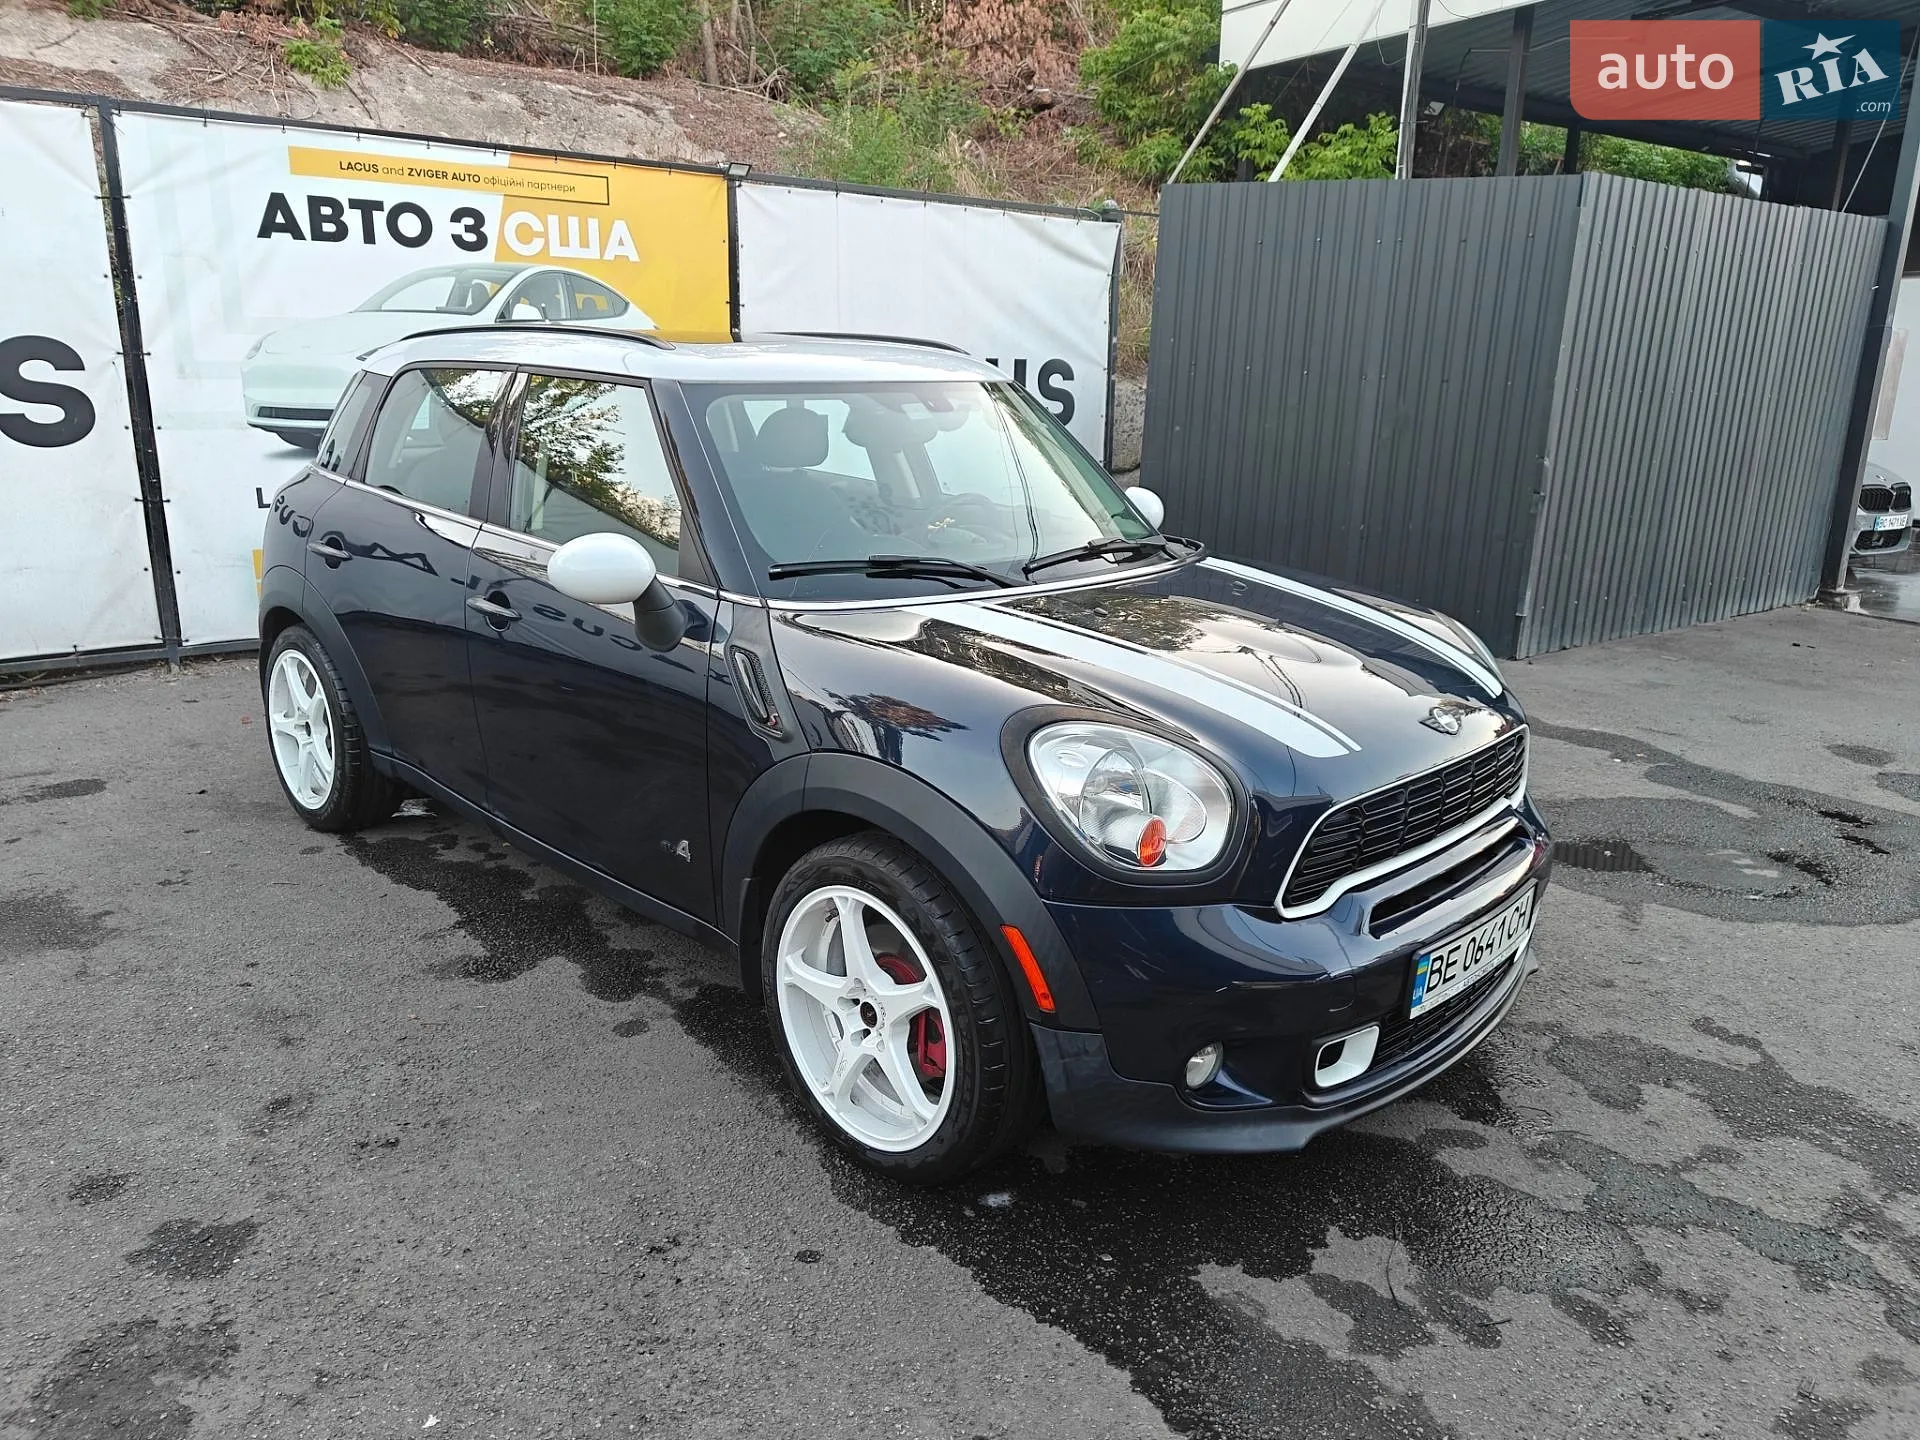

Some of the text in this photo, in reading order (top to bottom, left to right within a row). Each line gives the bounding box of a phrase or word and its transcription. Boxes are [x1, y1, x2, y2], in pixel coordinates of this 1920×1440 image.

[339, 160, 576, 194] LACUS and ZVIGER AUTO офіційні партнери
[257, 192, 433, 249] АВТО
[503, 211, 641, 263] США
[1425, 944, 1462, 994] BE
[1463, 915, 1507, 972] 0641
[1508, 895, 1530, 940] CH
